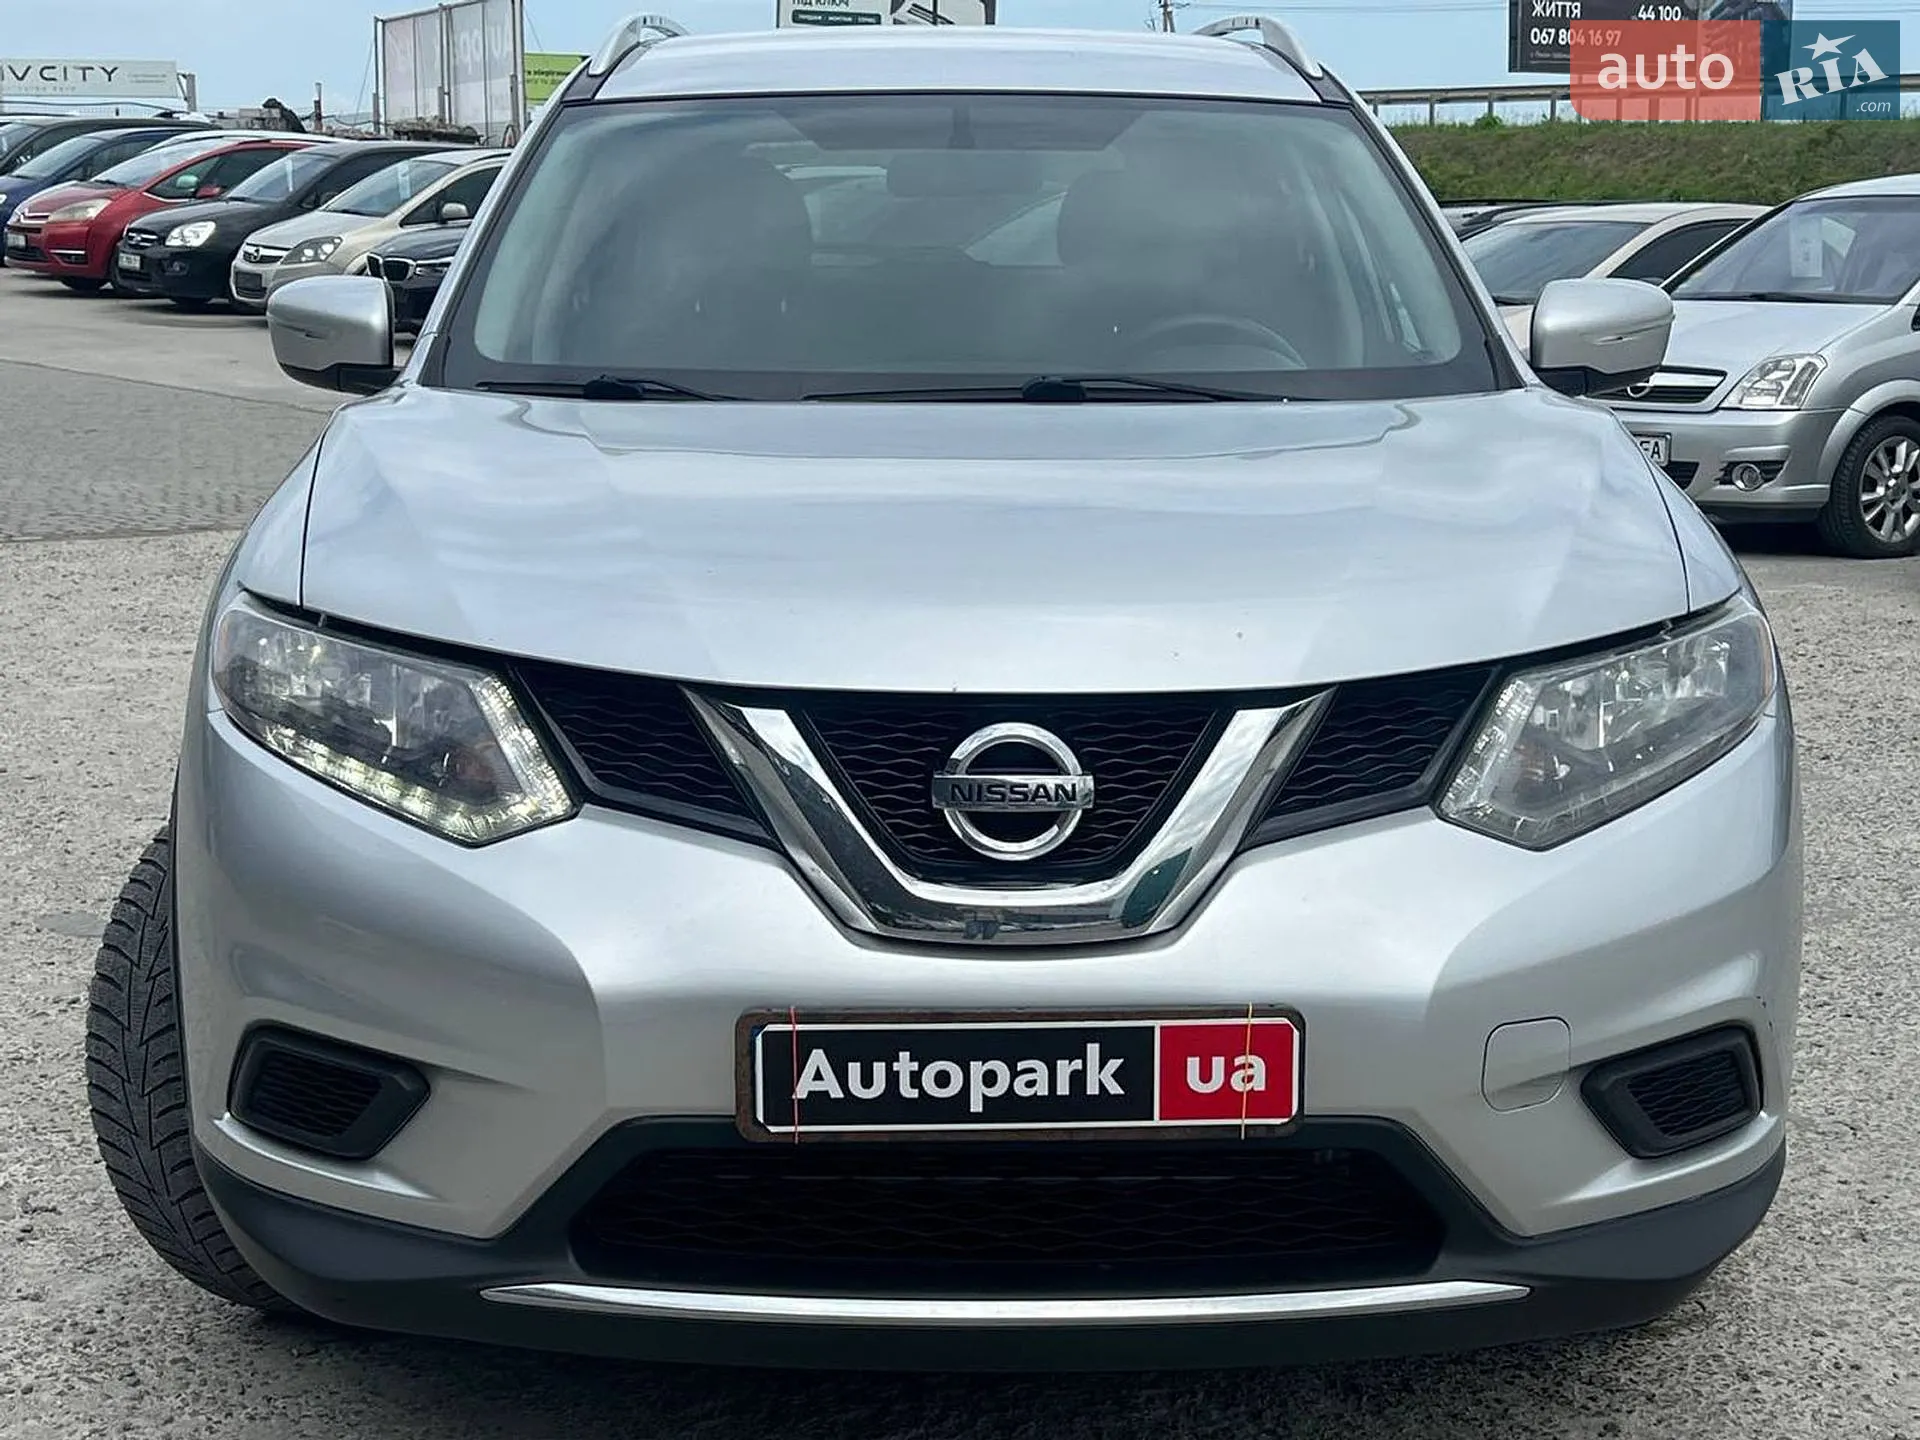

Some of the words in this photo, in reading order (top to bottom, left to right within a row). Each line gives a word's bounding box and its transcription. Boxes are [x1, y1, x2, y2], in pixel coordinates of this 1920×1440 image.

[1531, 0, 1581, 18] ЖИТТЯ
[1638, 4, 1655, 20] 44
[1659, 5, 1682, 21] 100
[1530, 27, 1555, 44] 067
[1558, 27, 1585, 45] 804
[1588, 29, 1603, 45] 16
[1606, 29, 1622, 46] 97
[950, 783, 1077, 802] NISSAN
[795, 1043, 1124, 1113] Autopark
[1186, 1053, 1267, 1094] ua
